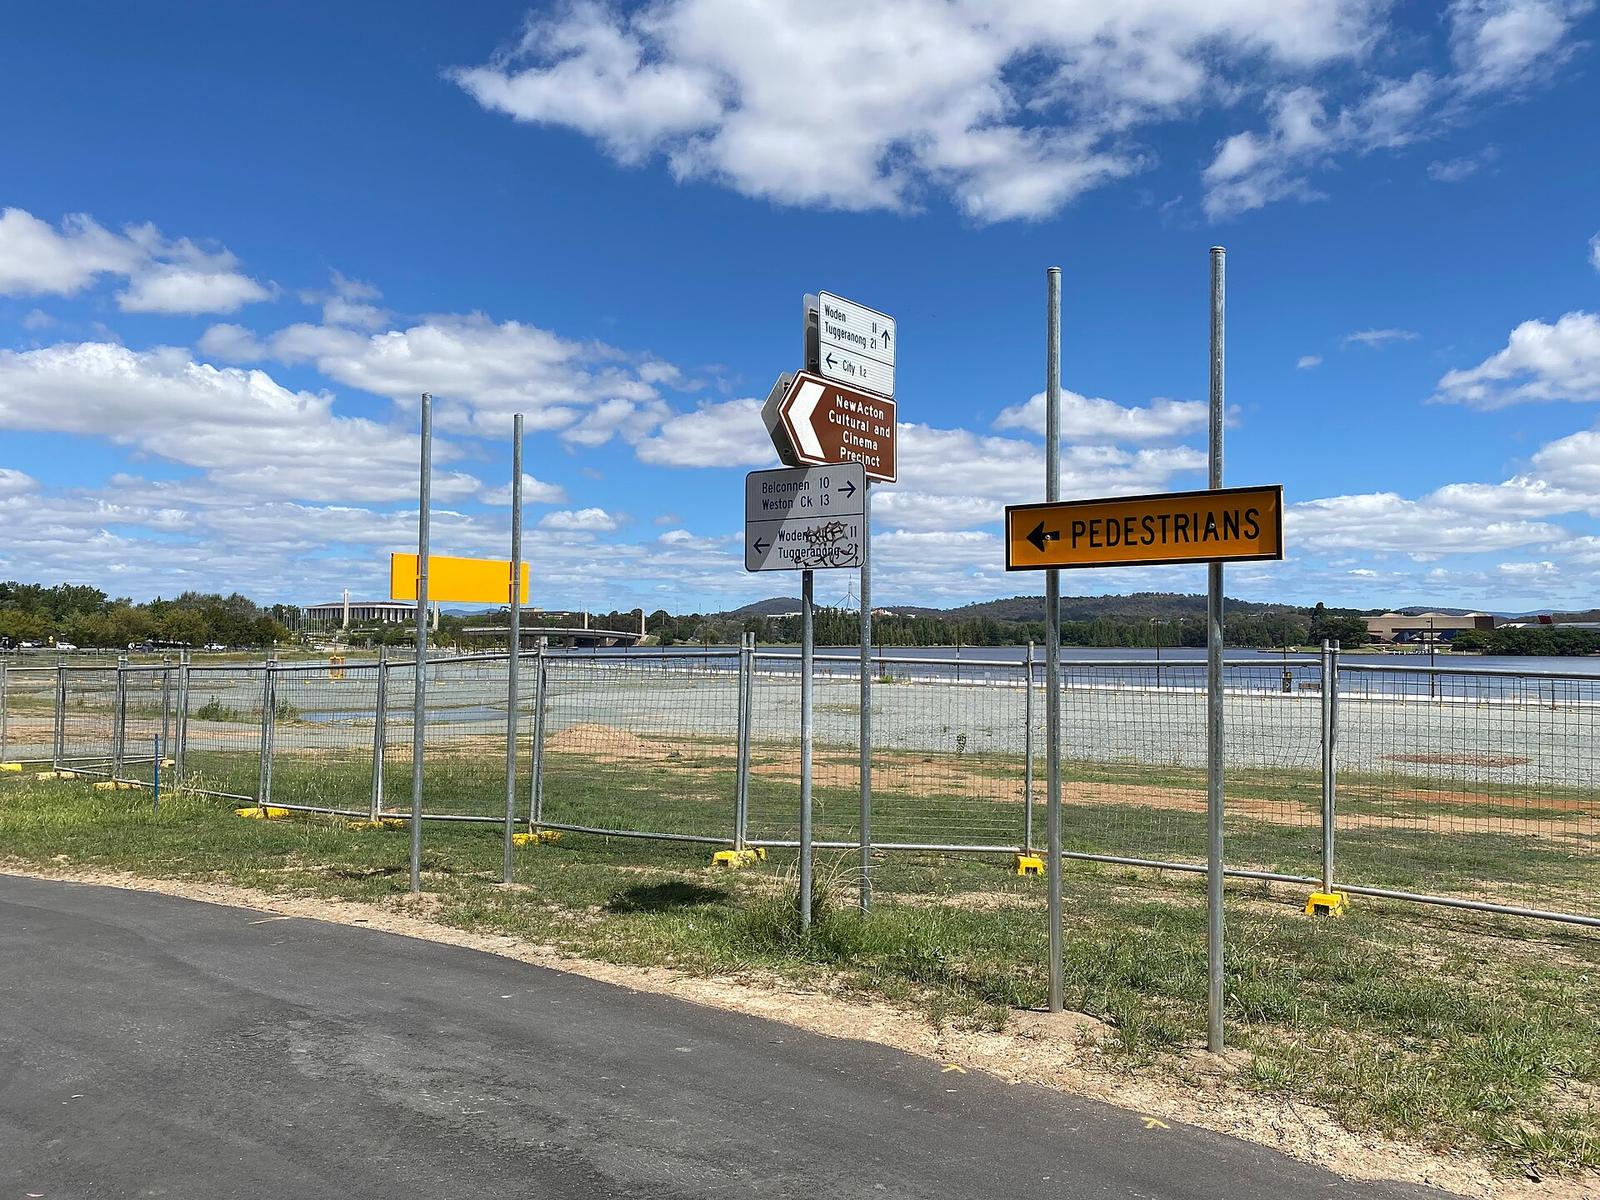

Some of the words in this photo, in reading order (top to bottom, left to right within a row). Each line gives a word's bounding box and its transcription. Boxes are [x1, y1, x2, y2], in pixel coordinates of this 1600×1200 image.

[824, 304, 847, 323] Woden
[872, 322, 877, 334] 11
[824, 321, 867, 349] Tuggeranong
[870, 338, 877, 349] 21
[842, 359, 856, 376] City
[836, 394, 884, 421] NewActon
[828, 409, 870, 432] Cultural
[874, 424, 890, 438] and
[843, 430, 878, 451] Cinema
[840, 447, 880, 467] Precinct
[762, 481, 810, 494] Belconnen
[819, 476, 830, 489] 10
[762, 499, 794, 510] Weston
[800, 496, 813, 507] Ck
[820, 494, 830, 506] 13
[778, 530, 811, 542] Woden
[850, 526, 857, 538] 11
[1071, 508, 1261, 549] PEDESTRIANS
[778, 546, 841, 561] Tuggeranong
